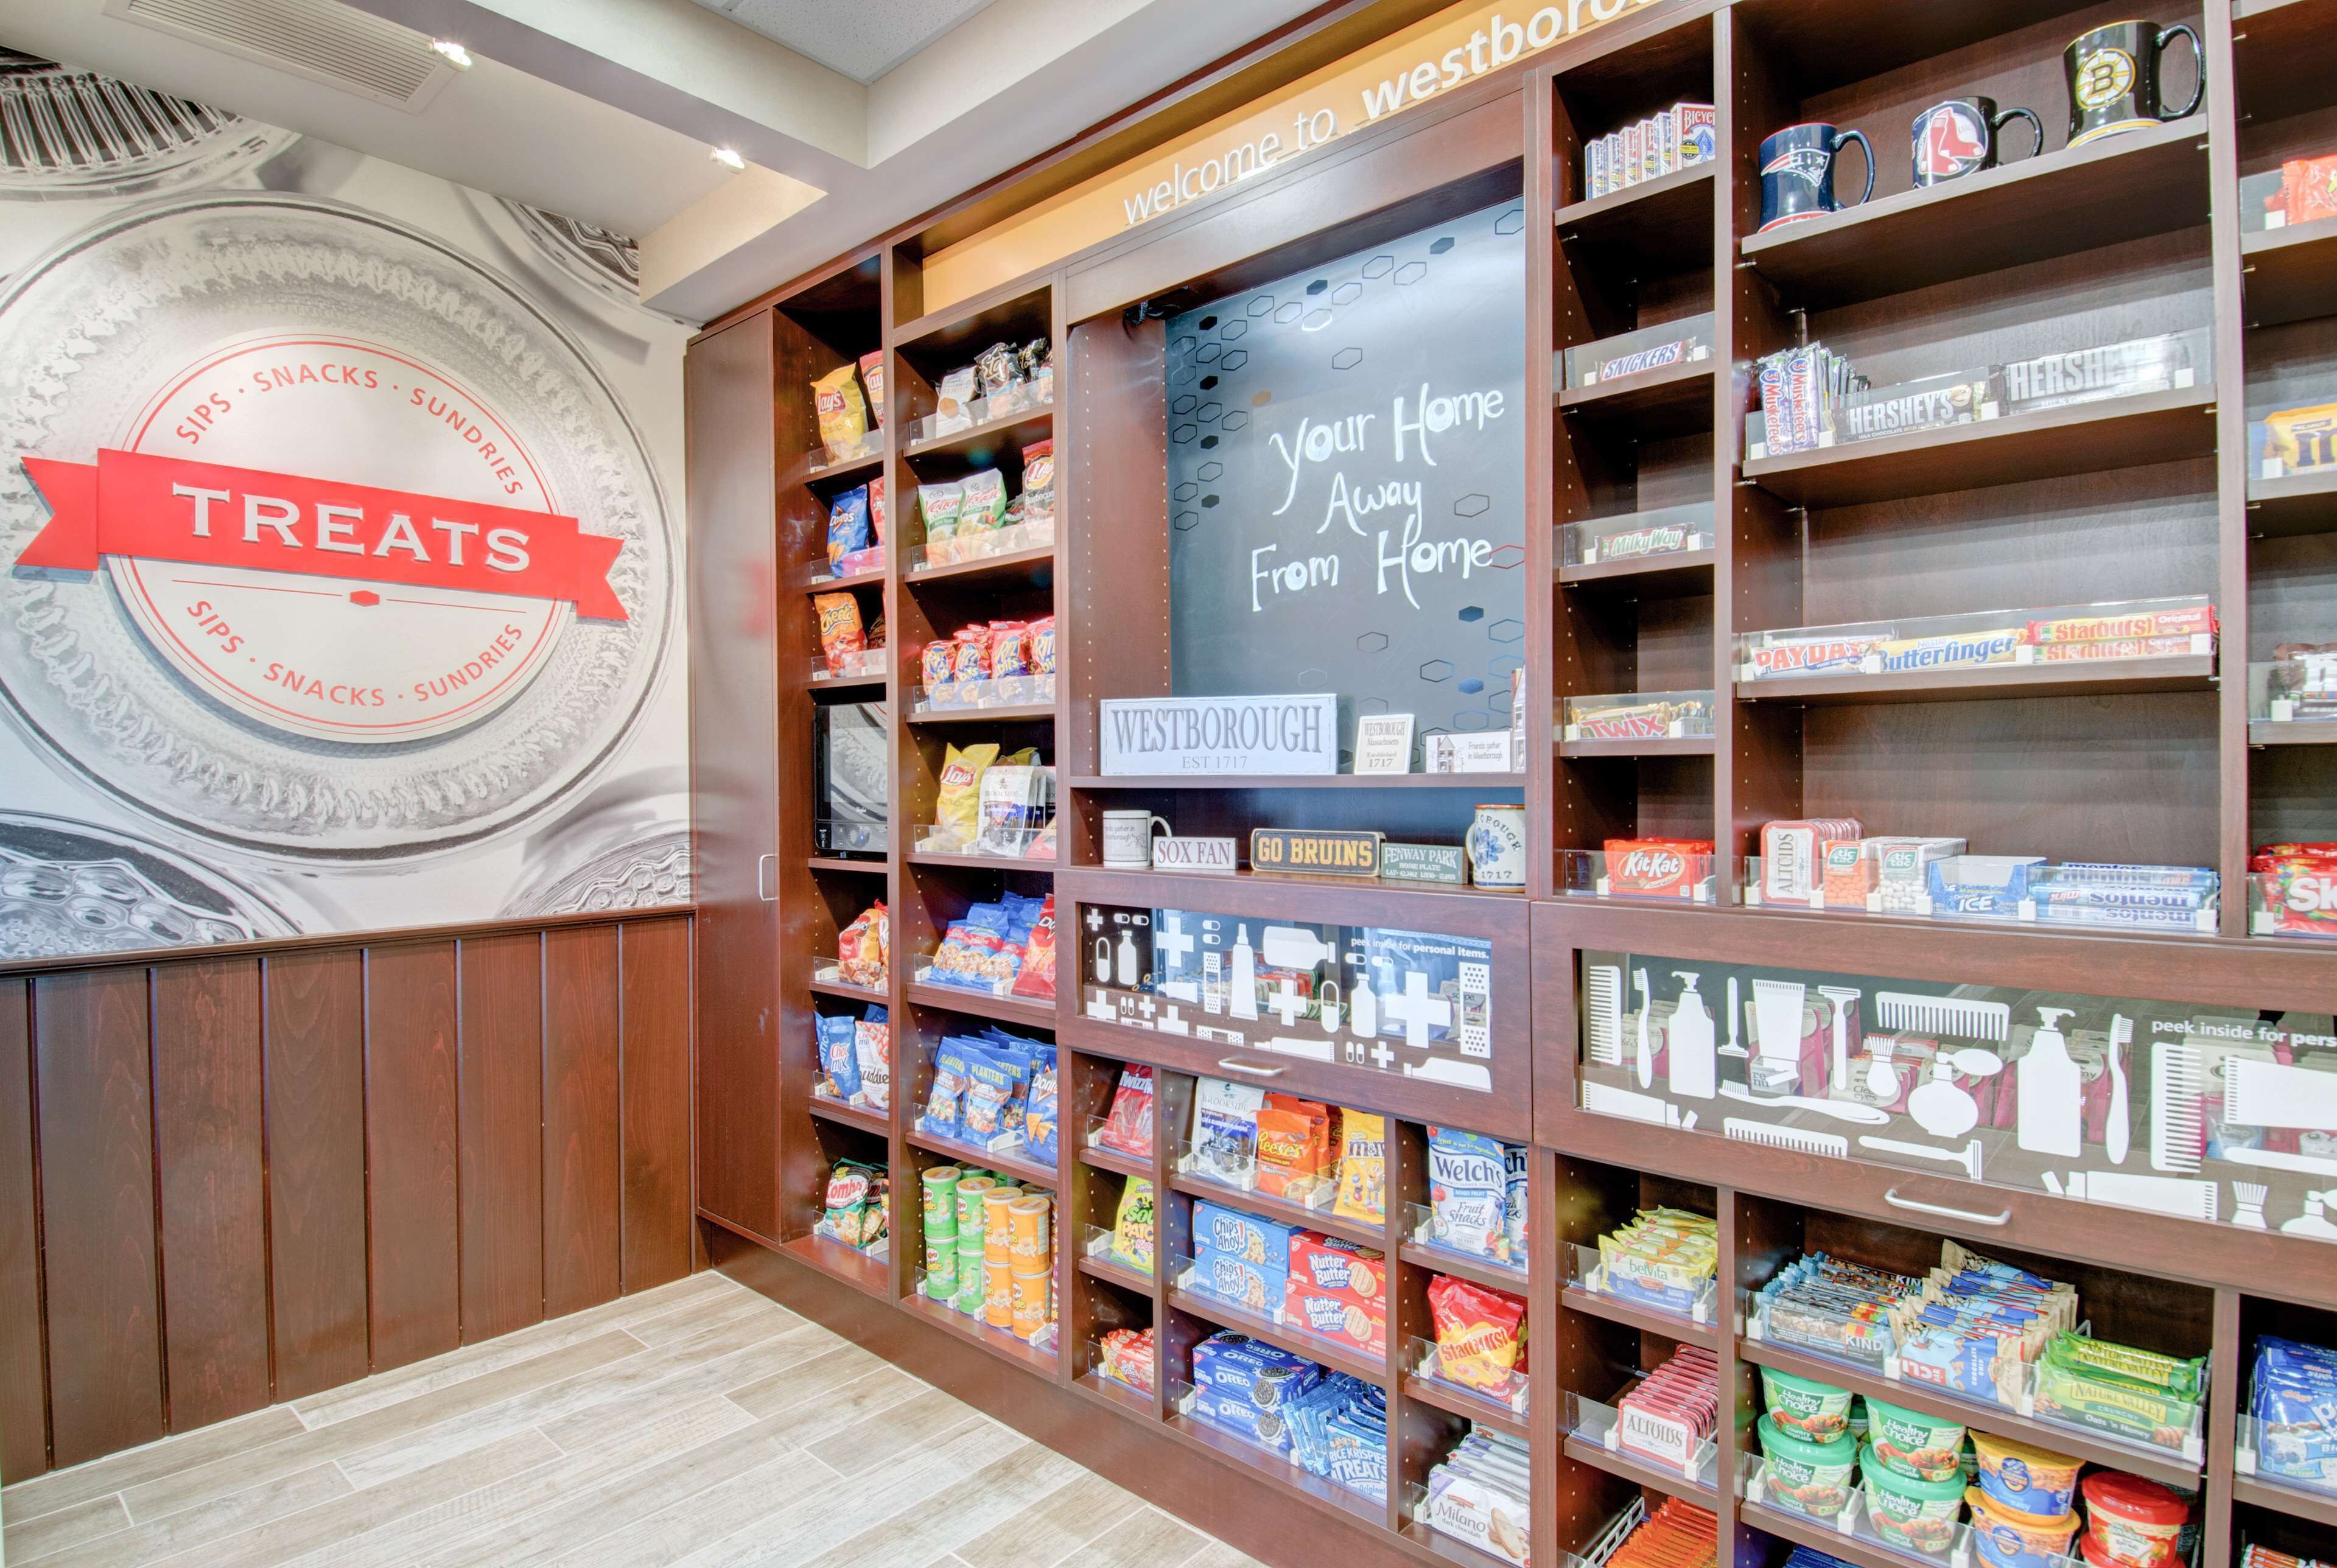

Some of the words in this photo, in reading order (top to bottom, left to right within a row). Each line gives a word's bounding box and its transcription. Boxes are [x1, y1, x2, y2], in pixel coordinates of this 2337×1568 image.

[2089, 65, 2115, 95] B
[1684, 110, 1714, 133] BICYC
[1125, 131, 1280, 225] welcome
[1298, 108, 1334, 148] to
[1604, 341, 1680, 380] SNICKERS
[1793, 361, 1804, 372] 3
[1764, 371, 1779, 382] 3
[1763, 383, 1783, 455] Musketeers
[1792, 373, 1806, 445] Musketeers
[1848, 391, 1955, 435] HERSHEY'S
[176, 390, 233, 445] SIPS
[252, 363, 380, 393] SNACKS
[412, 387, 524, 497] SUNDRIES
[1393, 383, 1505, 467] Home
[1871, 428, 1903, 438] CHOCOLATE
[1317, 472, 1423, 538] Away
[172, 481, 532, 576] TREATS
[1613, 532, 1650, 556] Milky
[1646, 527, 1681, 549] Way
[1251, 543, 1339, 612] From
[1377, 514, 1493, 610] Home
[2055, 618, 2153, 640] Starburst
[2158, 613, 2201, 625] Original
[187, 600, 245, 656] SIPS
[263, 662, 385, 708] SNACKS
[413, 623, 524, 703] SUNDRIES
[1754, 642, 1862, 674] PAYDAY
[1880, 637, 2017, 671] Butterfinger
[1111, 705, 1323, 754] WESTBOROUGH
[1364, 721, 1406, 737] WESTBOROUGH
[1468, 741, 1485, 750] Friends
[1182, 756, 1213, 769] EST
[1216, 755, 1248, 769] 1717
[1368, 758, 1393, 768] 1717
[1157, 840, 1192, 864] SOX
[1196, 841, 1232, 865] FAN
[1258, 836, 1283, 863] GO
[1289, 837, 1373, 867] BRUINS
[1384, 846, 1427, 864] FENWAY
[1428, 850, 1457, 869] PARK
[1833, 855, 1854, 865] tac
[1837, 849, 1855, 858] tic
[1895, 852, 1916, 861] tic
[1419, 863, 1442, 872] PLATE
[1891, 858, 1912, 868] tac
[1958, 896, 1993, 912] ICE
[2090, 891, 2189, 908] mentos
[2105, 908, 2192, 923] mentos
[1350, 937, 1371, 948] peek
[1373, 938, 1397, 950] inside
[1399, 941, 1411, 951] for
[1413, 944, 1456, 956] personal
[1457, 947, 1490, 959] items.
[2151, 1020, 2195, 1034] peek
[2200, 1022, 2254, 1040] inside
[2258, 1026, 2288, 1043] for
[2290, 1033, 2337, 1048] pers
[830, 1058, 849, 1073] mix
[971, 1063, 1004, 1086] PLANTERS
[1202, 1097, 1249, 1112] BROOKSIDE
[1258, 1132, 1302, 1159] Reese's
[1433, 1153, 1502, 1188] Welch's
[1447, 1209, 1487, 1227] Snacks
[1457, 1202, 1485, 1216] Fruit
[1213, 1217, 1239, 1237] Chips
[1308, 1254, 1346, 1272] Nutter
[1629, 1259, 1668, 1280] belVita
[1314, 1268, 1351, 1286] Butter
[1304, 1297, 1342, 1314] Nutter
[1309, 1311, 1346, 1328] Butter
[1440, 1328, 1508, 1362] Starburst
[1845, 1335, 1883, 1351] KIND
[1222, 1351, 1264, 1367] OREO
[1215, 1371, 1250, 1388] OREO
[1778, 1395, 1819, 1414] Choice
[1781, 1388, 1821, 1406] Healthy
[2076, 1383, 2119, 1404] NATURE
[2123, 1396, 2162, 1420] VALLEY
[2097, 1405, 2139, 1421] CRUNCHY
[1627, 1413, 1683, 1447] ALTOIDS
[1785, 1424, 1812, 1437] Country
[1785, 1430, 1813, 1443] Vegetable
[1882, 1425, 1926, 1447] Choice
[1885, 1418, 1929, 1438] Healthy
[2084, 1414, 2107, 1426] Oats
[2120, 1423, 2151, 1440] Honey
[1329, 1448, 1347, 1461] RICE
[1347, 1447, 1386, 1464] KRISPIES
[1890, 1458, 1917, 1472] Country
[1331, 1460, 1386, 1482] TREATS
[1772, 1463, 1810, 1483] Choice
[1774, 1456, 1813, 1476] Healthy
[1889, 1464, 1919, 1479] Vegetable
[1359, 1484, 1386, 1495] Original
[1879, 1489, 1922, 1510] Healthy
[1876, 1494, 1919, 1517] Choice
[1435, 1501, 1486, 1533] Milano
[1442, 1517, 1454, 1528] dark
